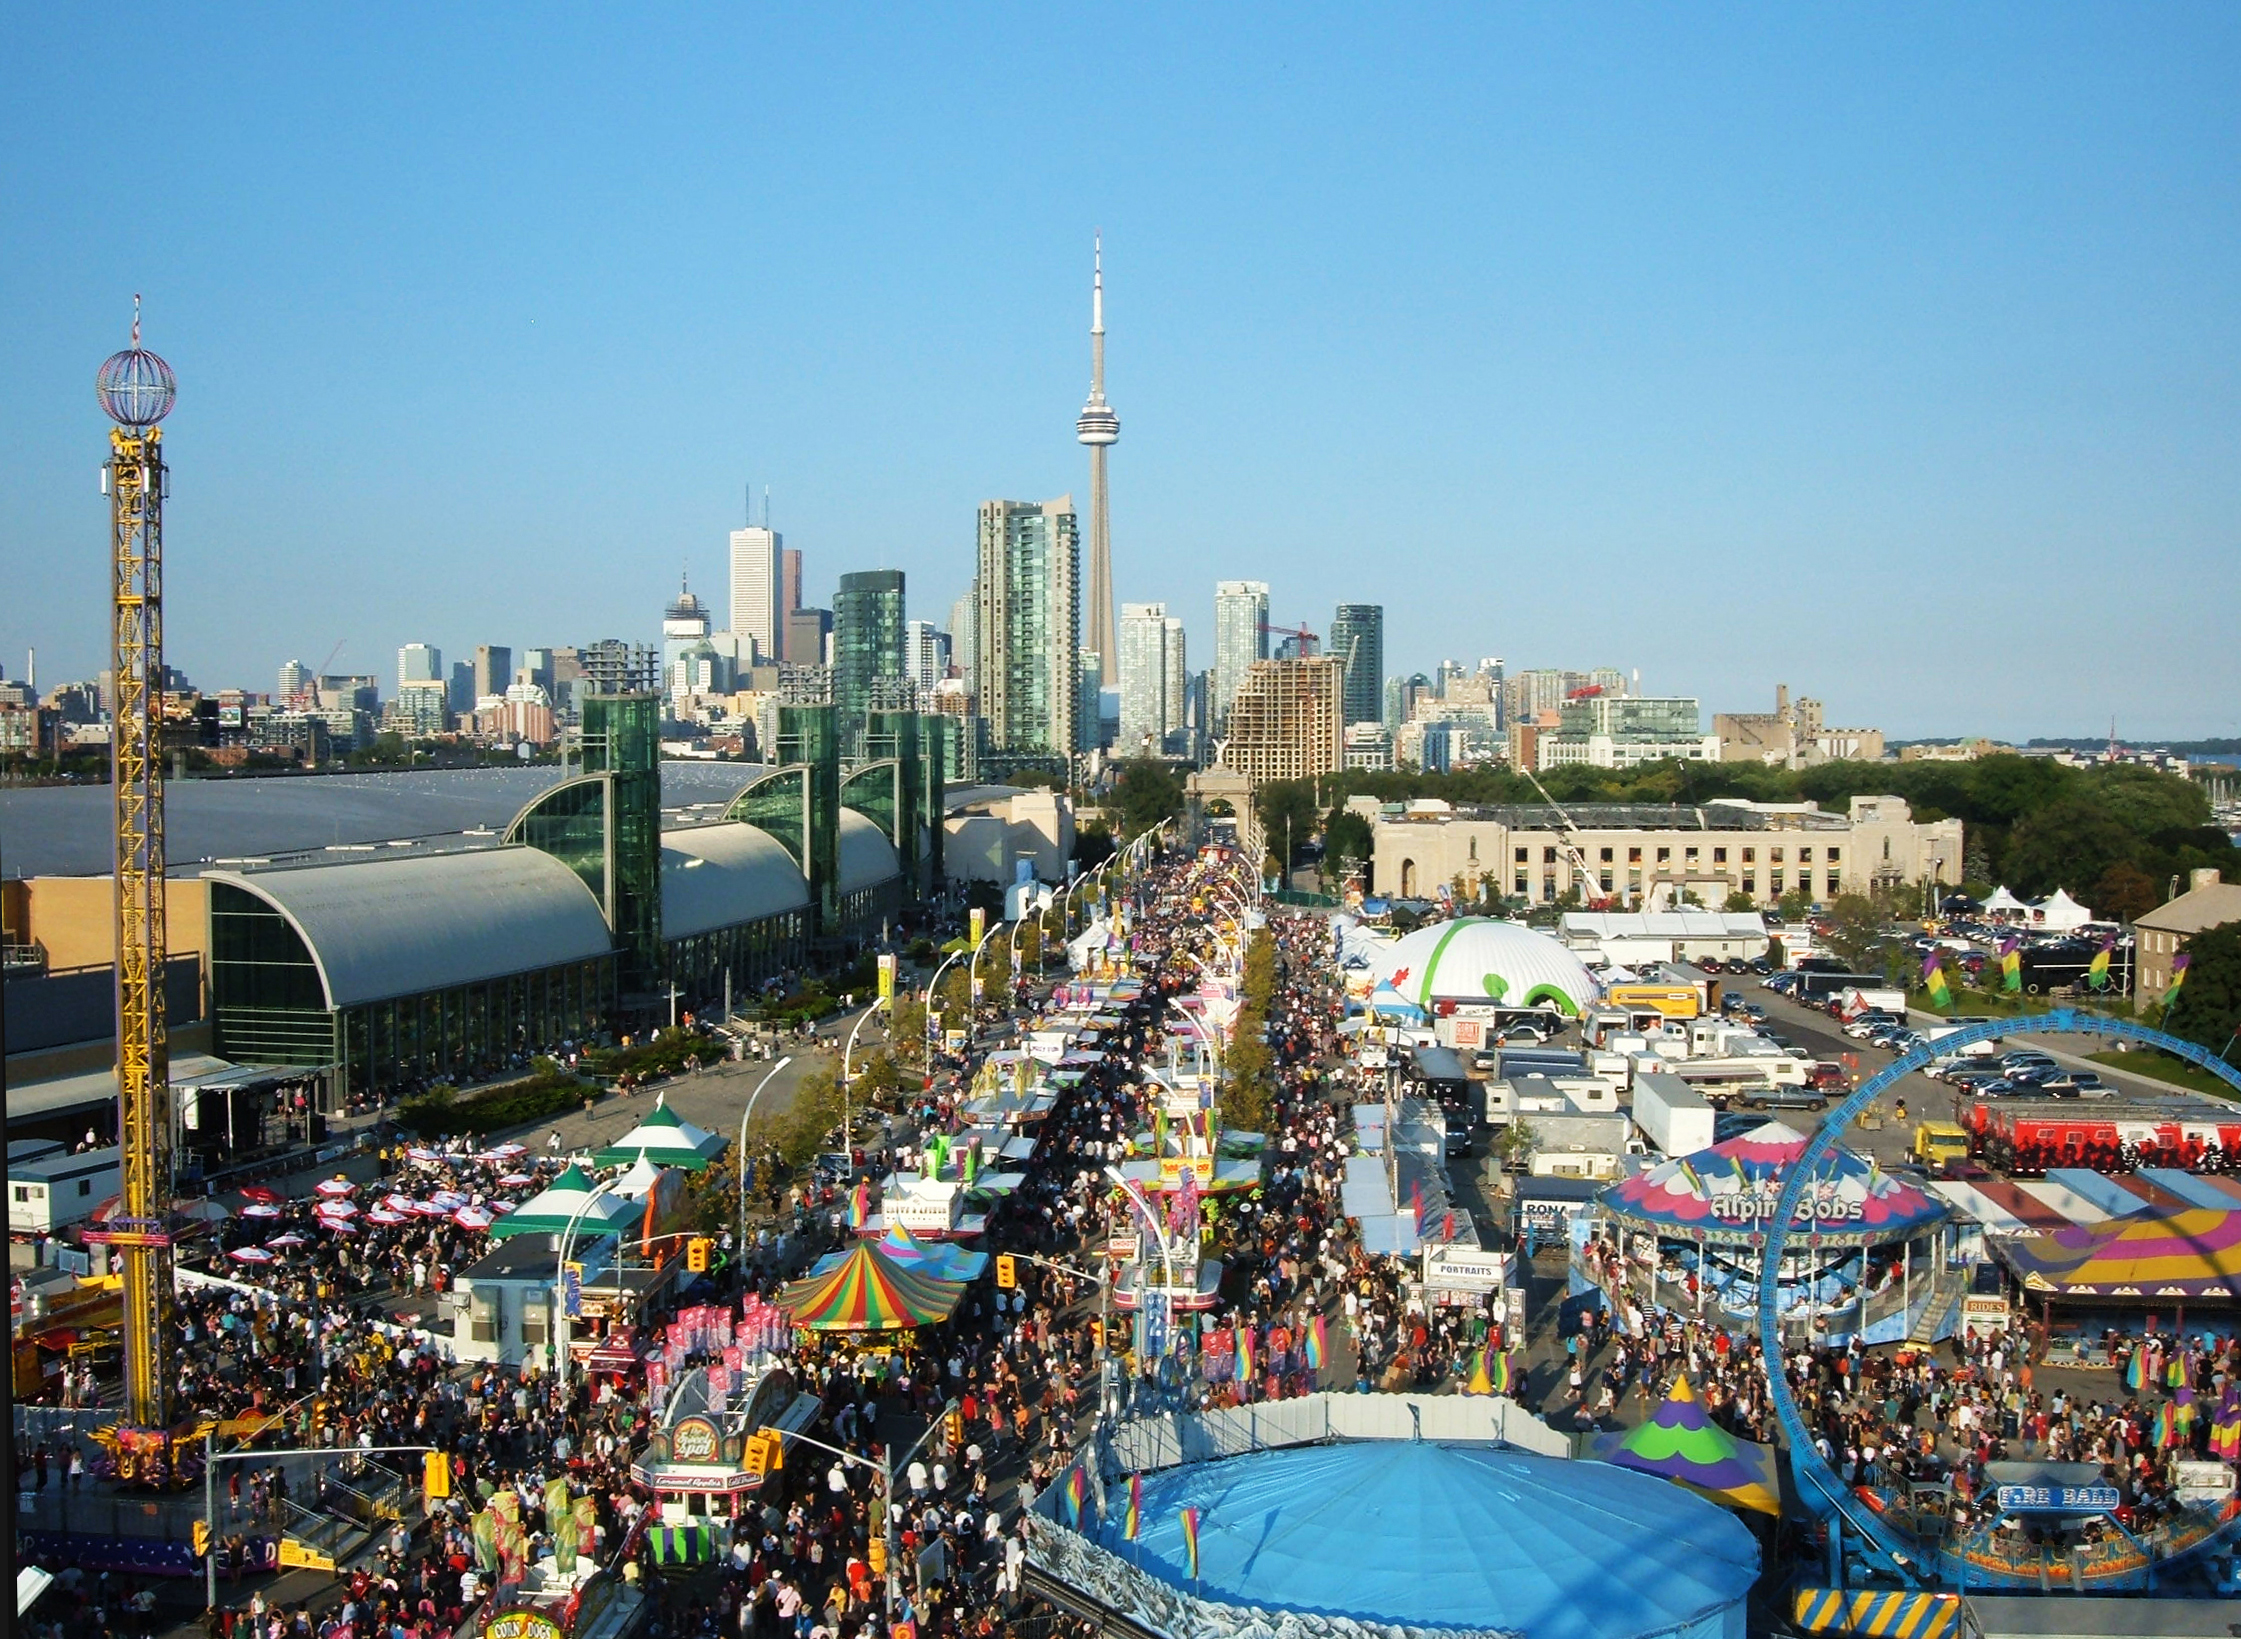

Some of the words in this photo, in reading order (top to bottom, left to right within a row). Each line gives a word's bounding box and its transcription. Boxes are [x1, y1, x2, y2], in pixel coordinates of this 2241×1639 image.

[1526, 1204, 1567, 1215] RONA
[1710, 1192, 1780, 1223] Alpin
[1794, 1194, 1864, 1221] Bobs
[1440, 1265, 1492, 1276] PORTRAITS
[1970, 1302, 2004, 1312] RIDES
[2061, 1488, 2116, 1507] BALL
[494, 1620, 520, 1639] CORN
[527, 1621, 551, 1639] DOGS
